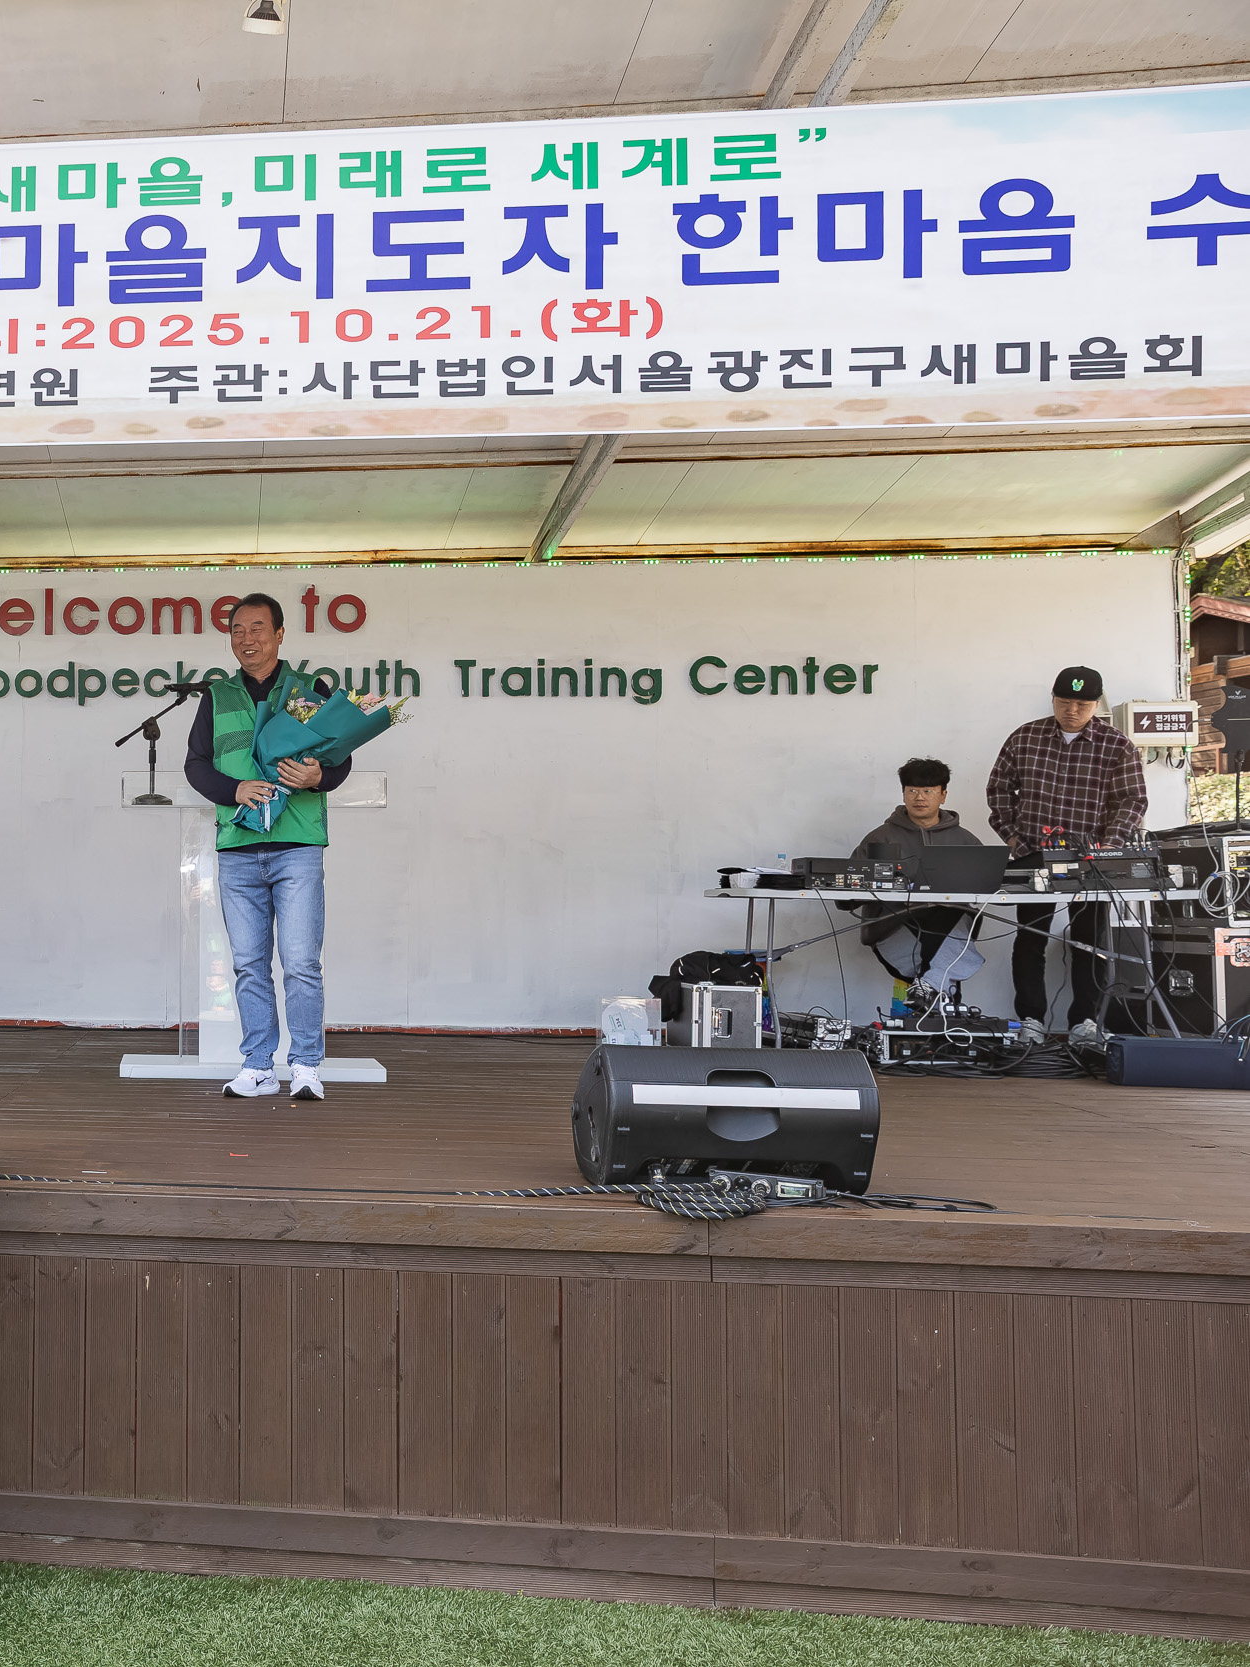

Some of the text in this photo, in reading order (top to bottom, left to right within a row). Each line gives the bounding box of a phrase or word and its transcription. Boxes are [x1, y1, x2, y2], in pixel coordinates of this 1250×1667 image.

[672, 178, 1076, 286] 한마음
[301, 585, 367, 633] to
[454, 658, 663, 705] Training
[689, 655, 879, 696] Center
